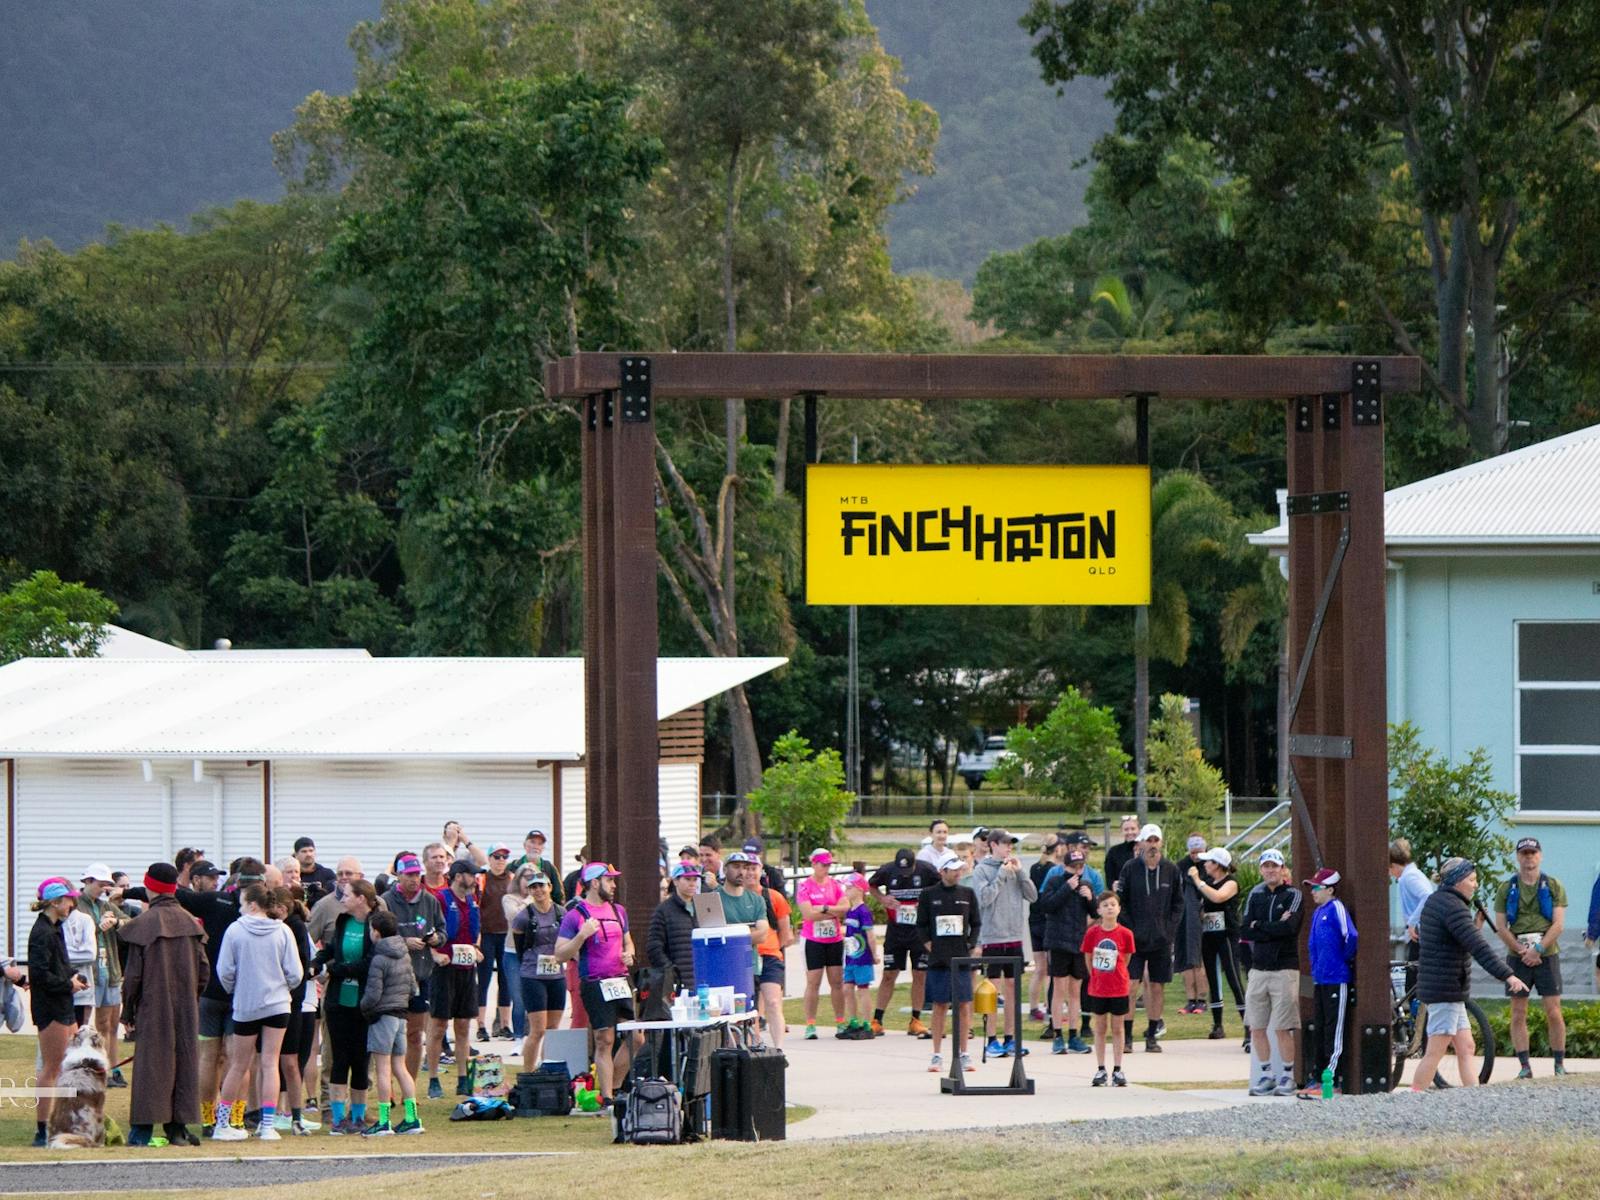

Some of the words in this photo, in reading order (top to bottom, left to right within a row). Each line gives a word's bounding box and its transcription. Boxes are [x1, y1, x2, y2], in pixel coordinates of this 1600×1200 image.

[840, 495, 869, 505] MTB
[1088, 566, 1117, 575] QLD
[900, 912, 916, 922] 147
[945, 923, 956, 934] 21
[1207, 919, 1221, 930] 106
[818, 926, 835, 937] 146
[457, 952, 473, 964] 138
[1096, 956, 1110, 969] 175
[607, 985, 627, 999] 184
